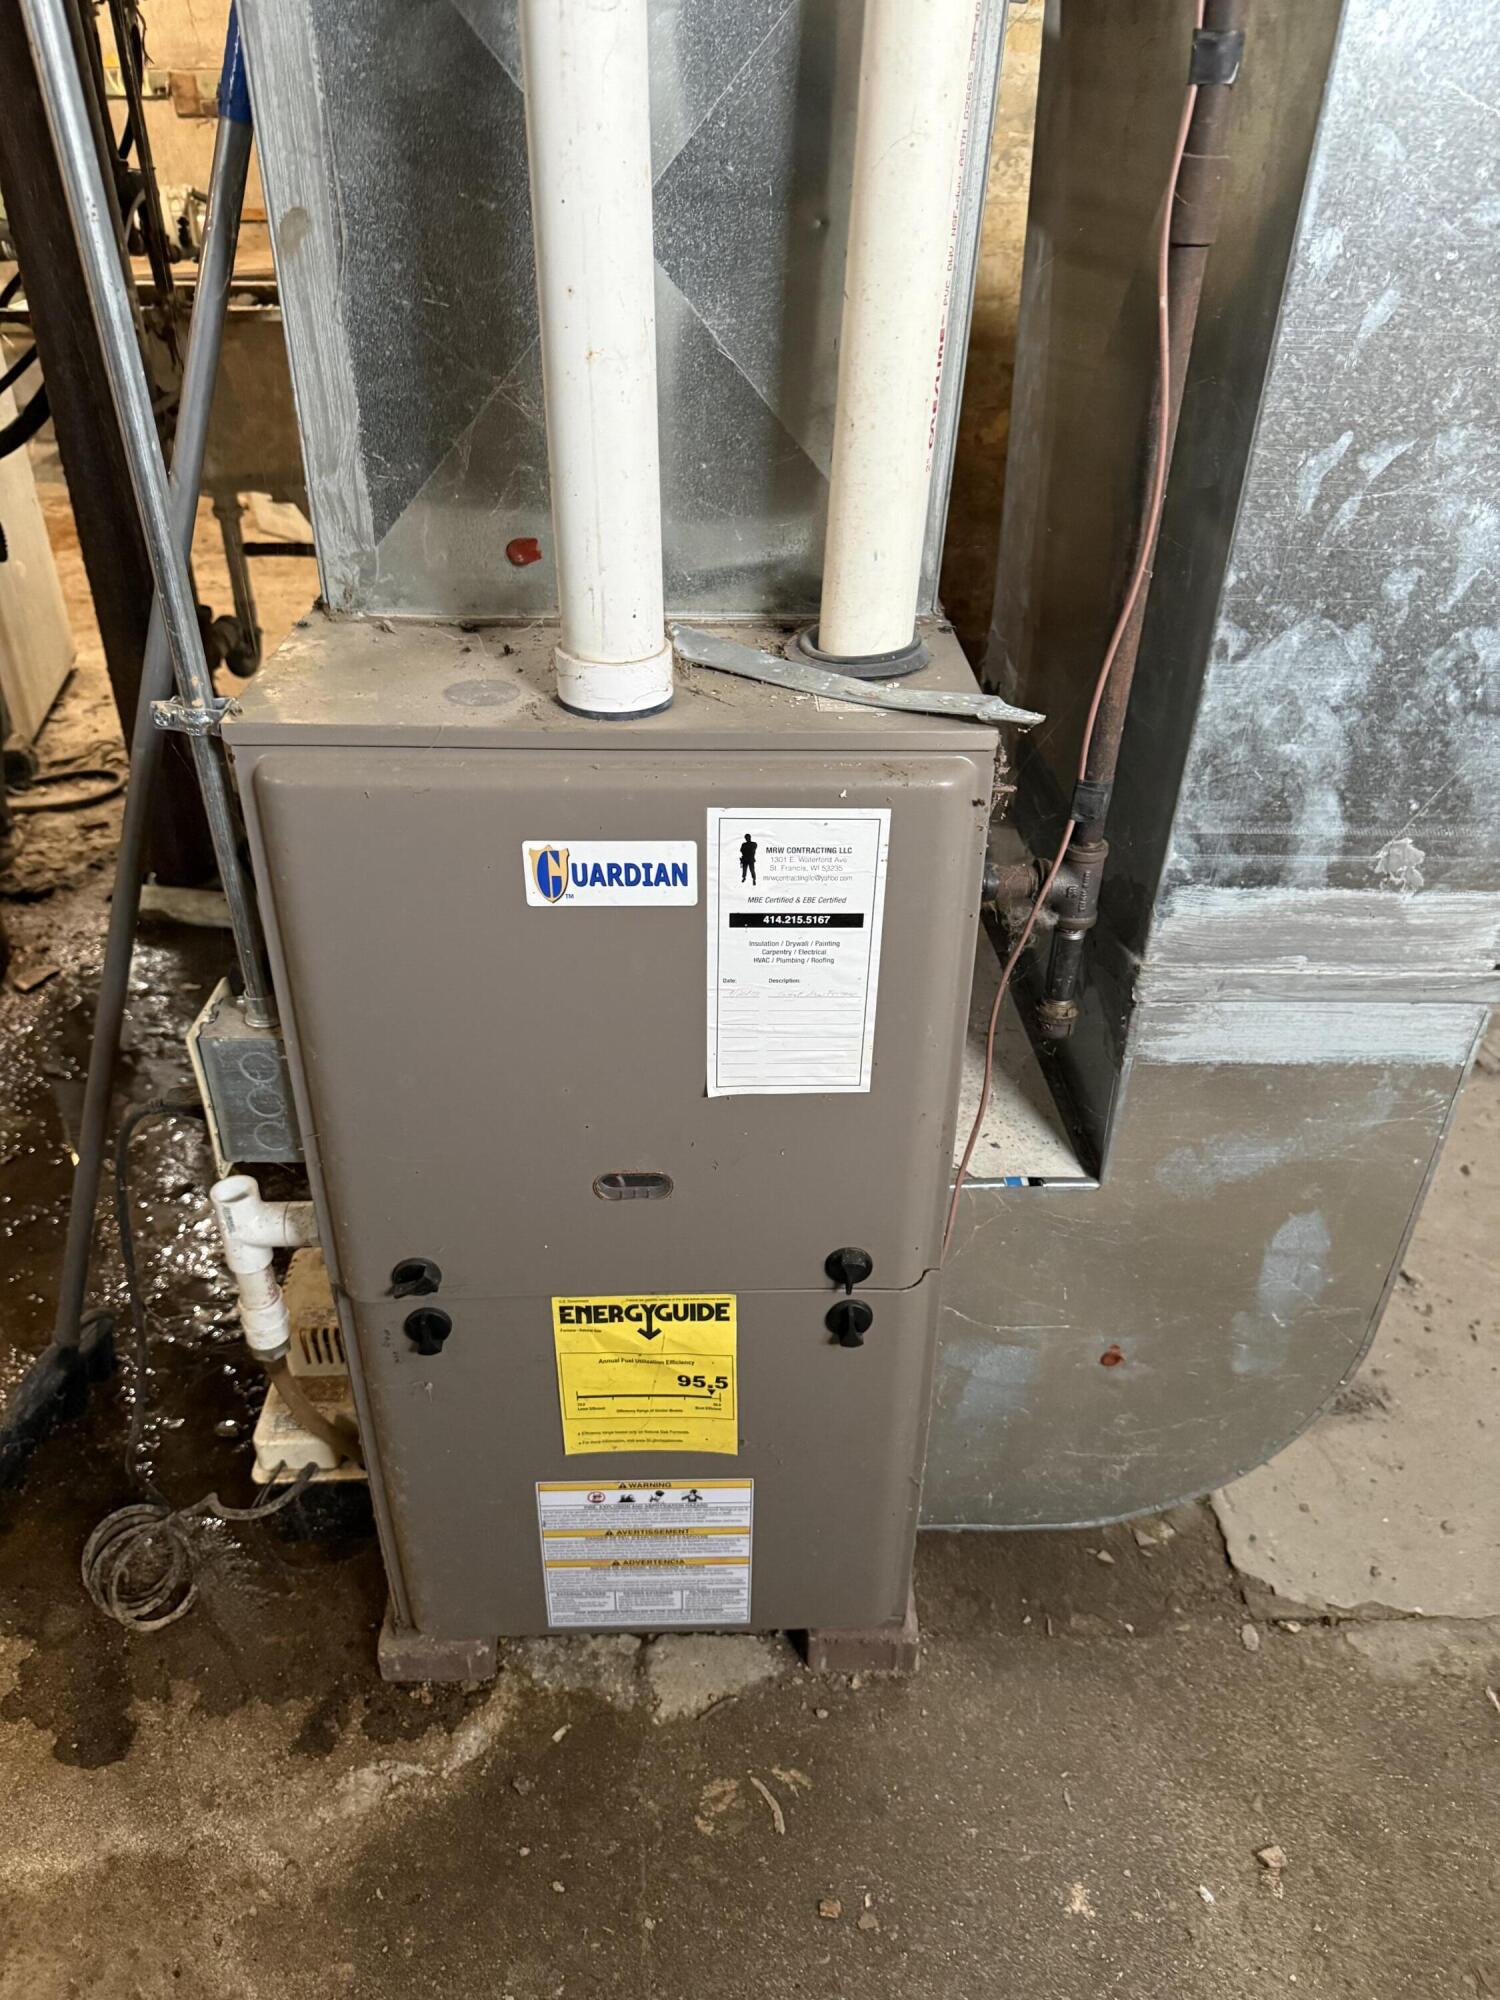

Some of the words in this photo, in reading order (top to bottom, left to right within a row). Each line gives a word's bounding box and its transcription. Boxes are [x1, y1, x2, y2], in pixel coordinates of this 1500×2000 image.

[942, 280, 951, 307] PVC
[958, 129, 968, 167] ASTM
[963, 71, 974, 120] D2665
[765, 846, 785, 854] MRW
[786, 846, 837, 854] CONTRACTING
[838, 846, 853, 854] LLC
[810, 864, 820, 872] WI
[534, 848, 689, 899] GUARDIAN
[747, 896, 763, 904] MBE
[764, 896, 794, 904] Certified
[794, 896, 800, 904] &
[802, 896, 817, 904] EBE
[818, 896, 847, 904] Certified
[762, 915, 831, 925] 414.215.5167
[785, 940, 809, 948] Drywall
[814, 940, 841, 948] Painting
[776, 957, 805, 965] Plumbing
[810, 957, 835, 965] Roofing
[559, 1302, 731, 1327] ENERGYGUIDE
[666, 1359, 696, 1367] Efficiency
[676, 1374, 729, 1390] 95.5
[616, 1528, 690, 1536] AVERTISSEMENT
[623, 1558, 686, 1566] ADVERTENCIA
